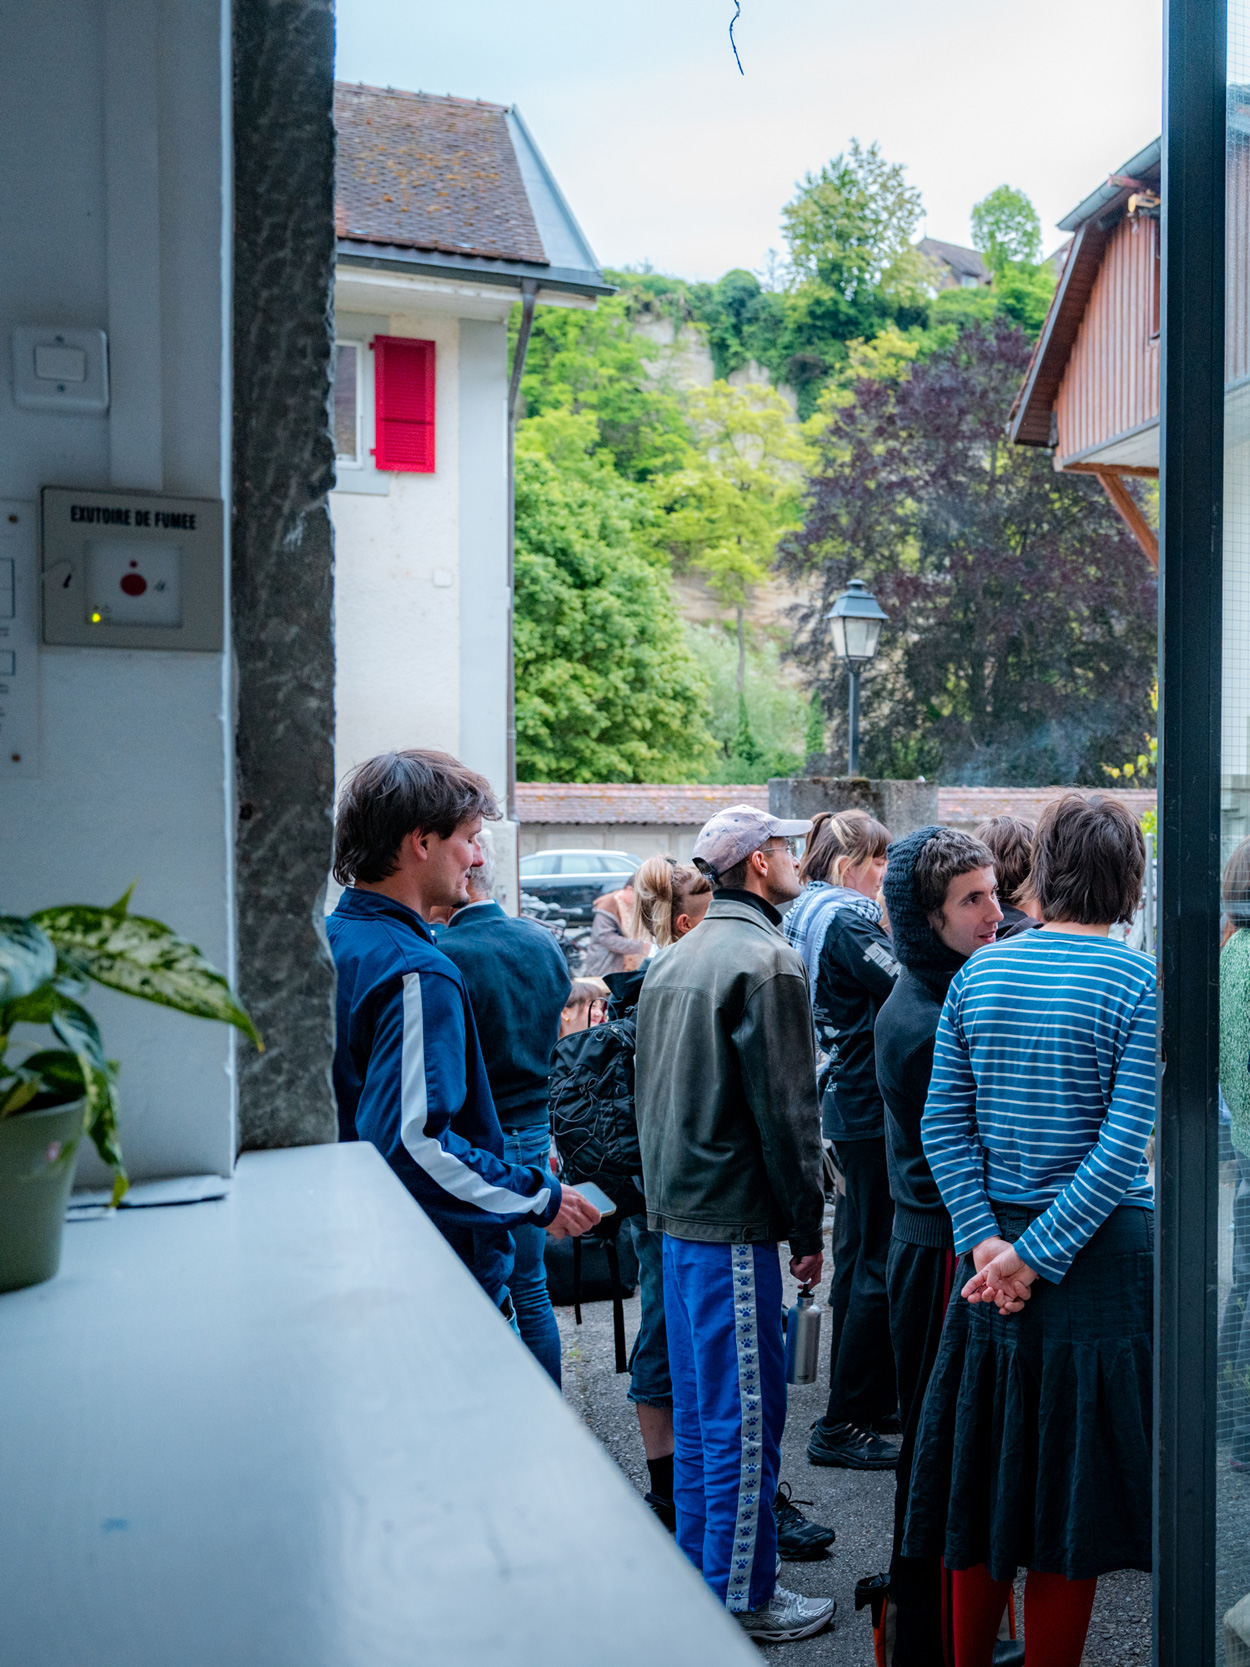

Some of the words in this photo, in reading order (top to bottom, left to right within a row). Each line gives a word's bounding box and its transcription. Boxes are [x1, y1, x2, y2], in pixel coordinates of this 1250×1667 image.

[71, 505, 131, 527] EXUTOIRE
[135, 509, 150, 527] DE
[155, 510, 196, 530] FUMEE
